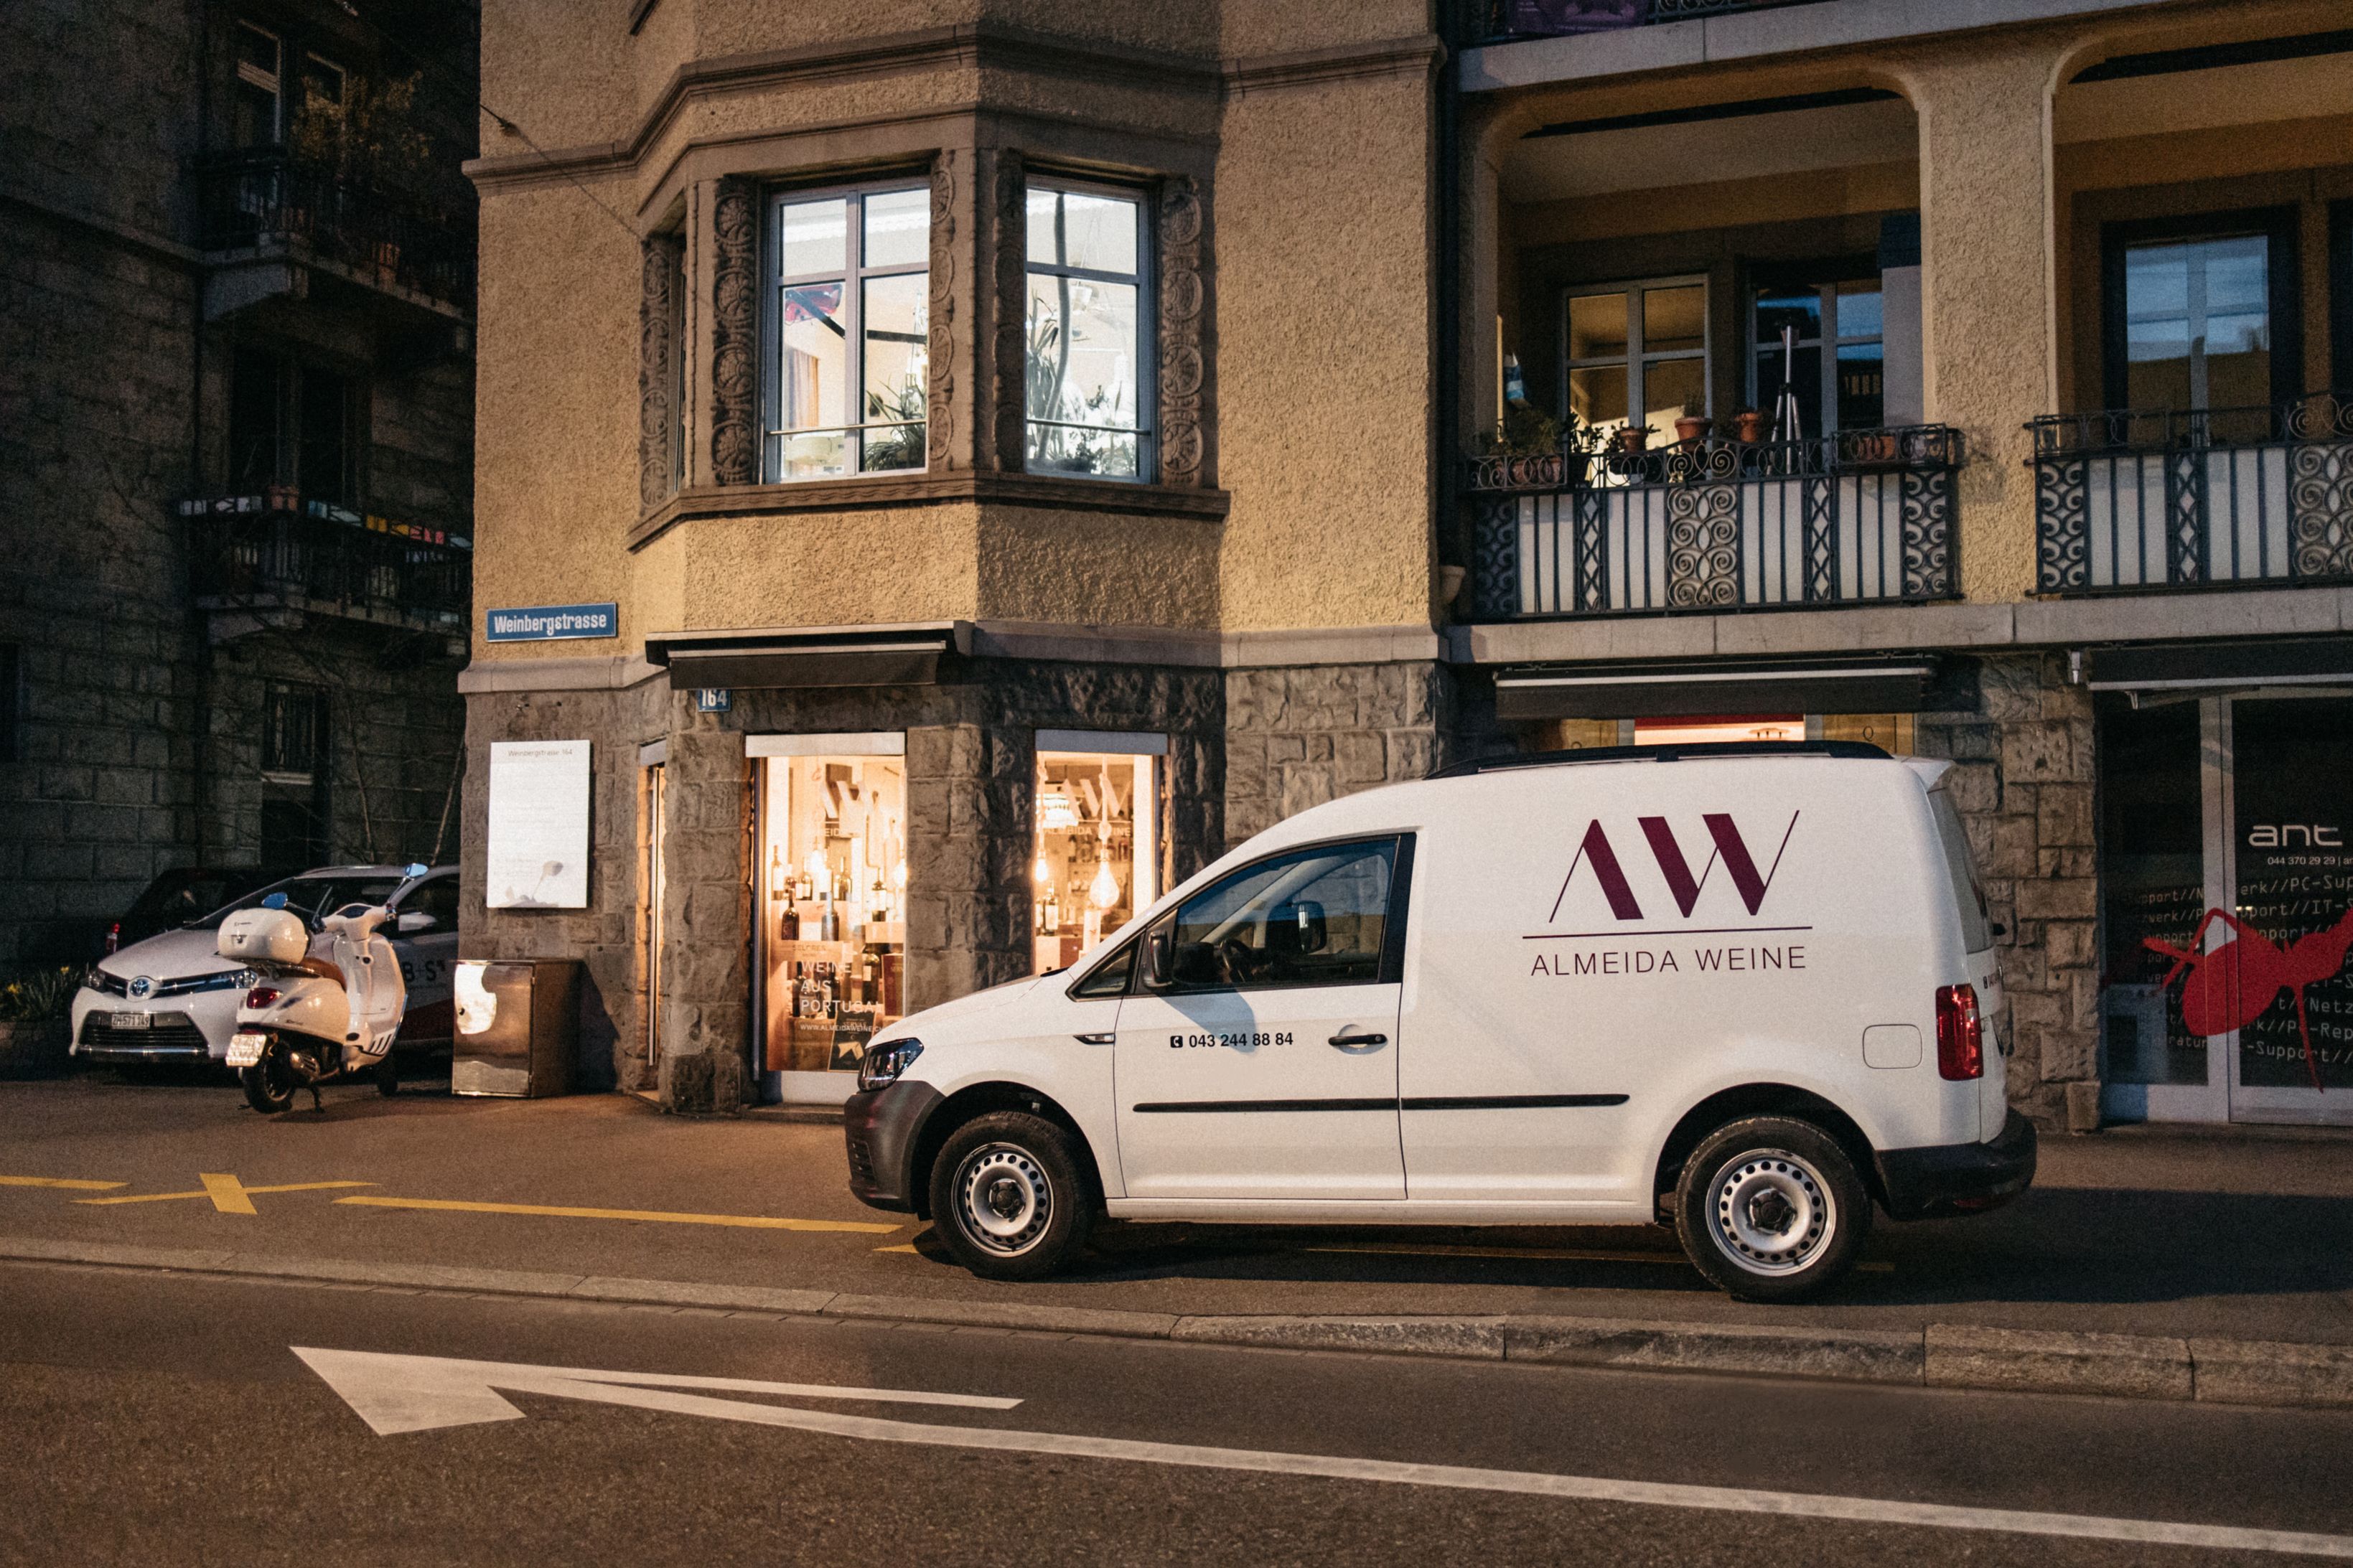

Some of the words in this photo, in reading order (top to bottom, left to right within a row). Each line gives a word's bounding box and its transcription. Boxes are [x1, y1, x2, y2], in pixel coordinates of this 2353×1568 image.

[494, 613, 607, 637] Weinbergstrasse
[701, 689, 728, 707] 164
[507, 749, 560, 759] Weinbergstrasse
[2248, 825, 2343, 847] ant
[1548, 809, 1800, 924] AW
[2268, 856, 2286, 865] 044
[2288, 856, 2306, 865] 370
[2308, 856, 2321, 865] 29
[2324, 856, 2336, 865] 29
[801, 960, 852, 974] WEINE
[1530, 949, 1679, 977] ALMEIDA
[1695, 946, 1807, 971] WEINE
[800, 979, 833, 993] AUS
[800, 999, 884, 1013] PORTUGAL
[1189, 1035, 1216, 1048] 043
[1220, 1033, 1248, 1047] 244
[1253, 1033, 1271, 1046] 88
[1275, 1032, 1294, 1046] 84
